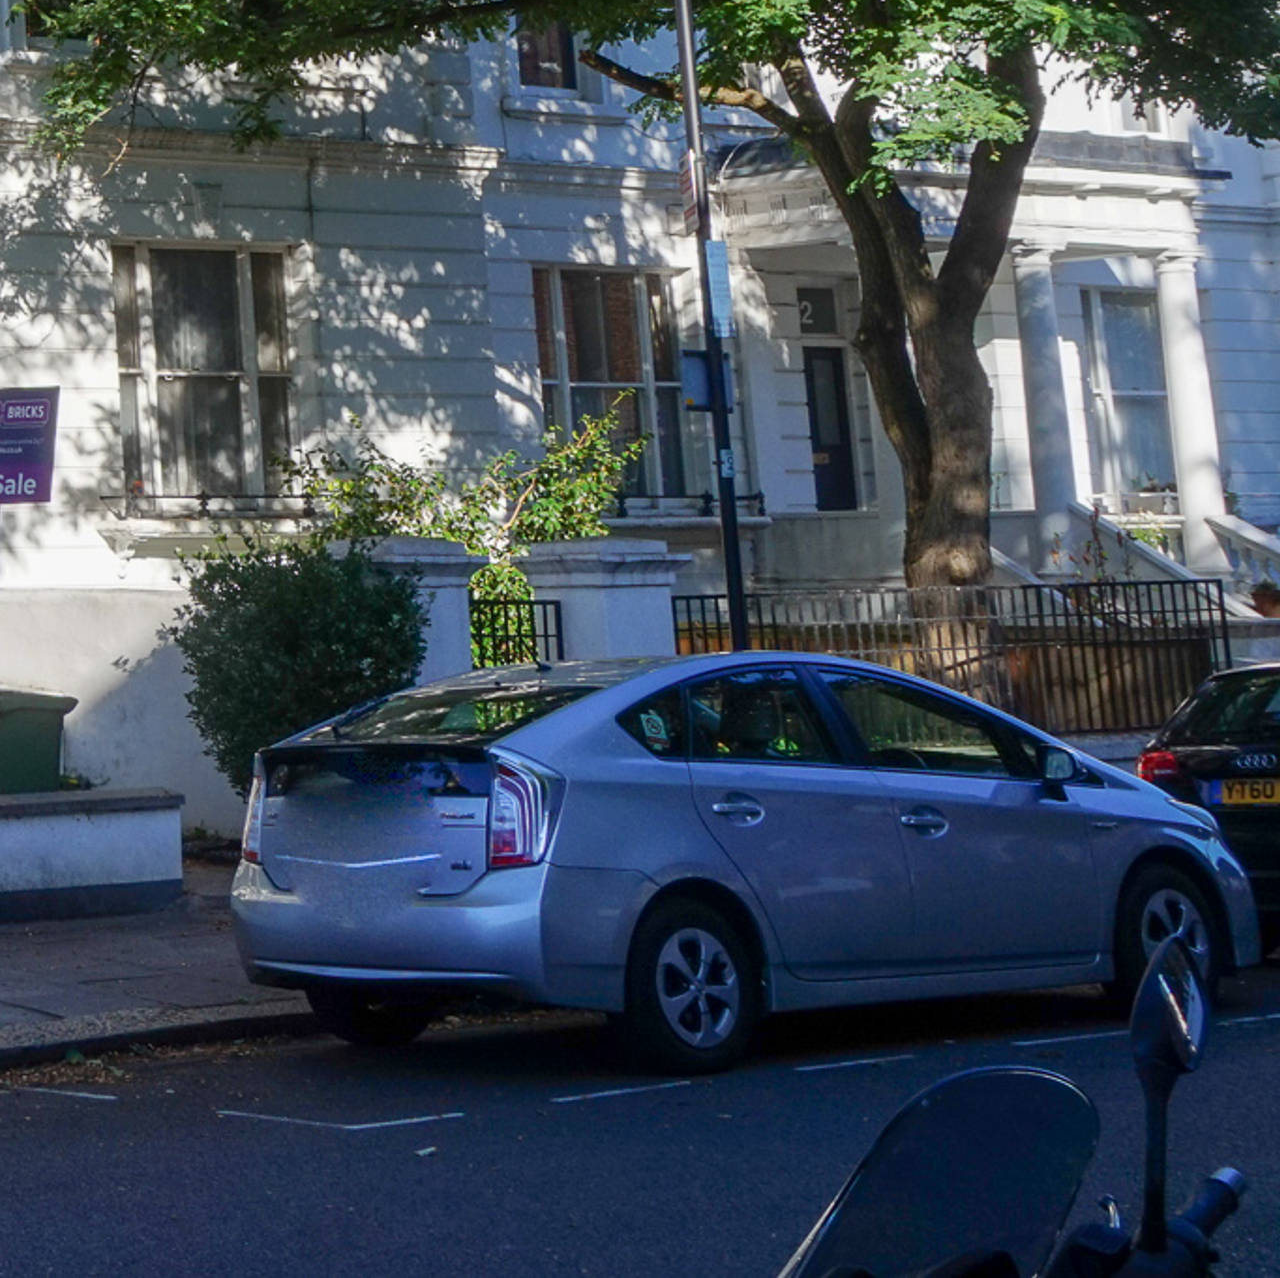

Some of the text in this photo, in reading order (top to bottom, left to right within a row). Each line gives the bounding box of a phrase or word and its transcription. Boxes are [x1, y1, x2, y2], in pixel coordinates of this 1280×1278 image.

[800, 300, 814, 324] 2
[6, 404, 45, 420] BRICKS
[1223, 780, 1276, 800] YT60
